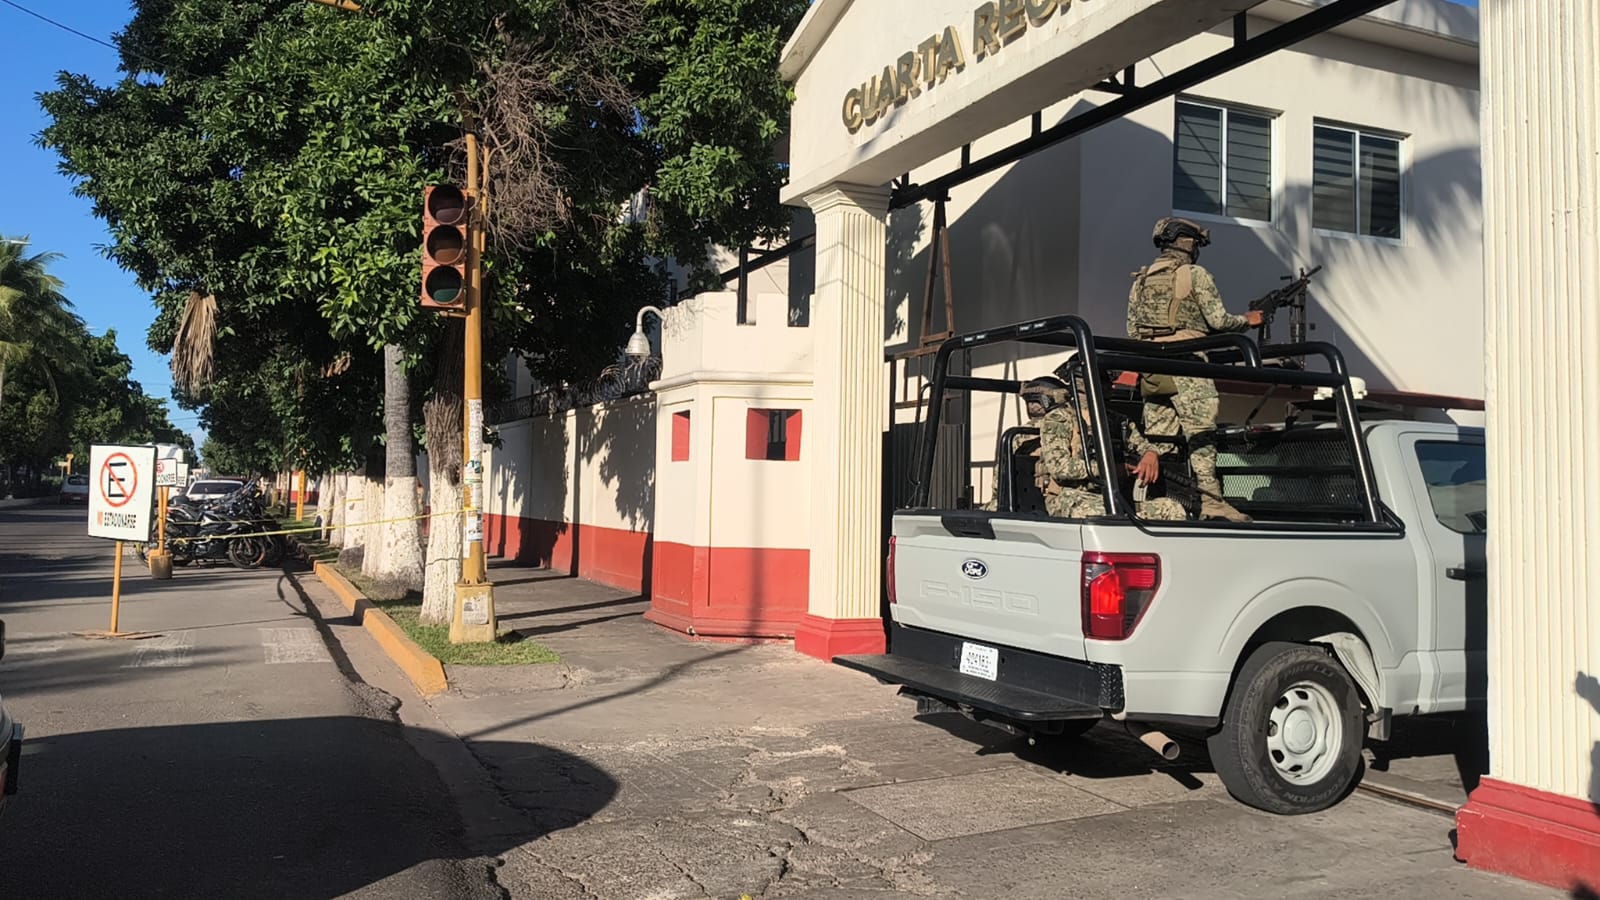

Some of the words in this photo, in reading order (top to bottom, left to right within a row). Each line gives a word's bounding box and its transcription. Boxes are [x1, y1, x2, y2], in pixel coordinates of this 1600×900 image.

[842, 25, 965, 134] CUARTA
[97, 511, 103, 526] NO
[104, 511, 137, 529] ESTACIONARSE
[963, 560, 985, 578] Ford
[920, 579, 1039, 616] F-150
